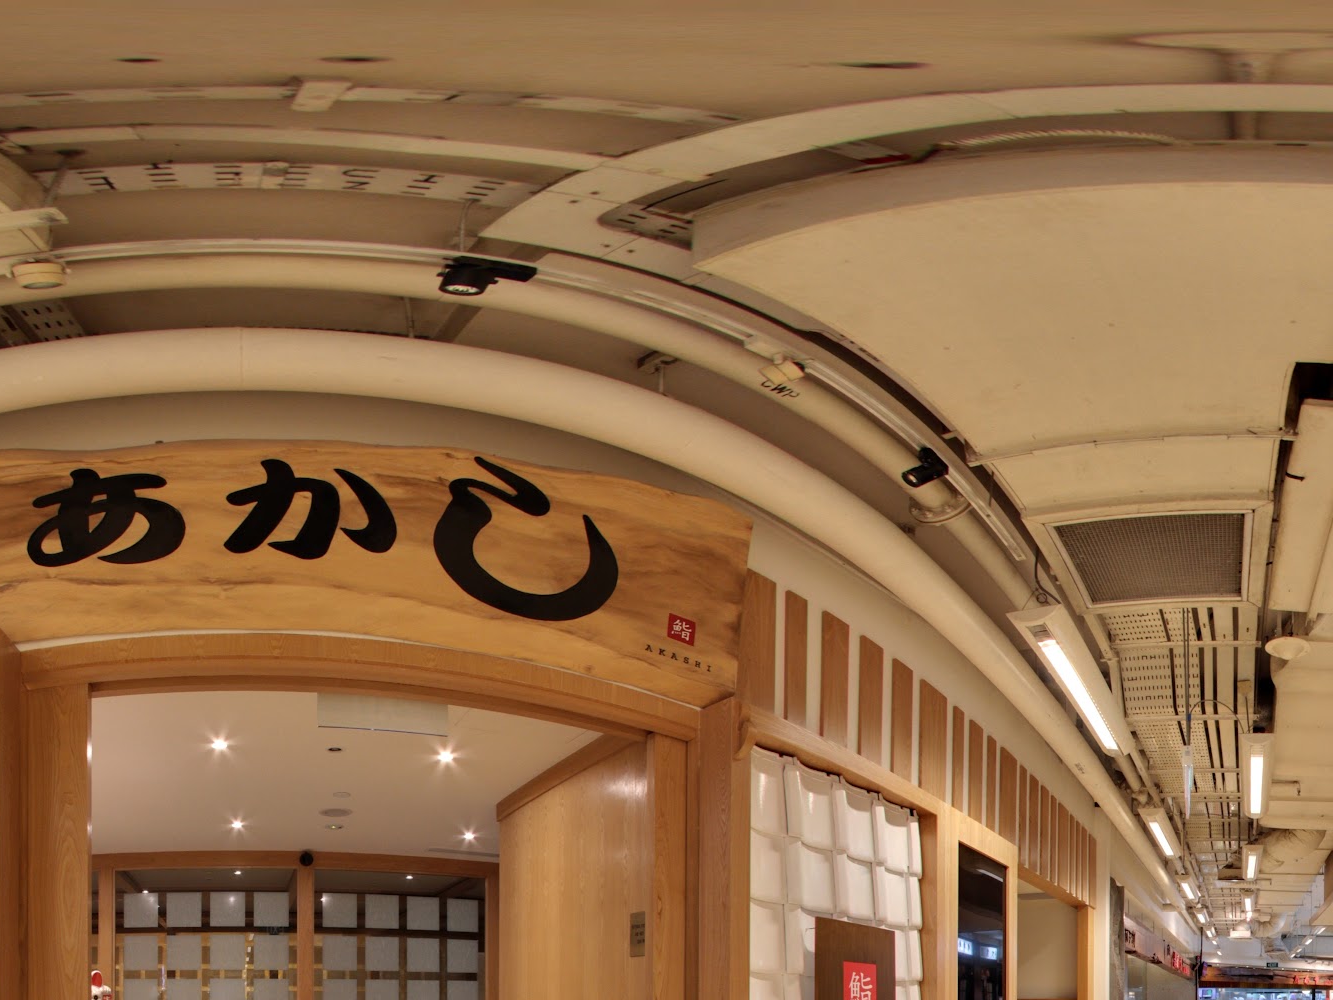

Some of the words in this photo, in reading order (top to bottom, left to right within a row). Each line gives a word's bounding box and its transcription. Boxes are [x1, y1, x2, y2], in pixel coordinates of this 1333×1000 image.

[27, 454, 619, 621] あかし
[671, 619, 692, 641] 鮨
[645, 644, 712, 673] AKASHI
